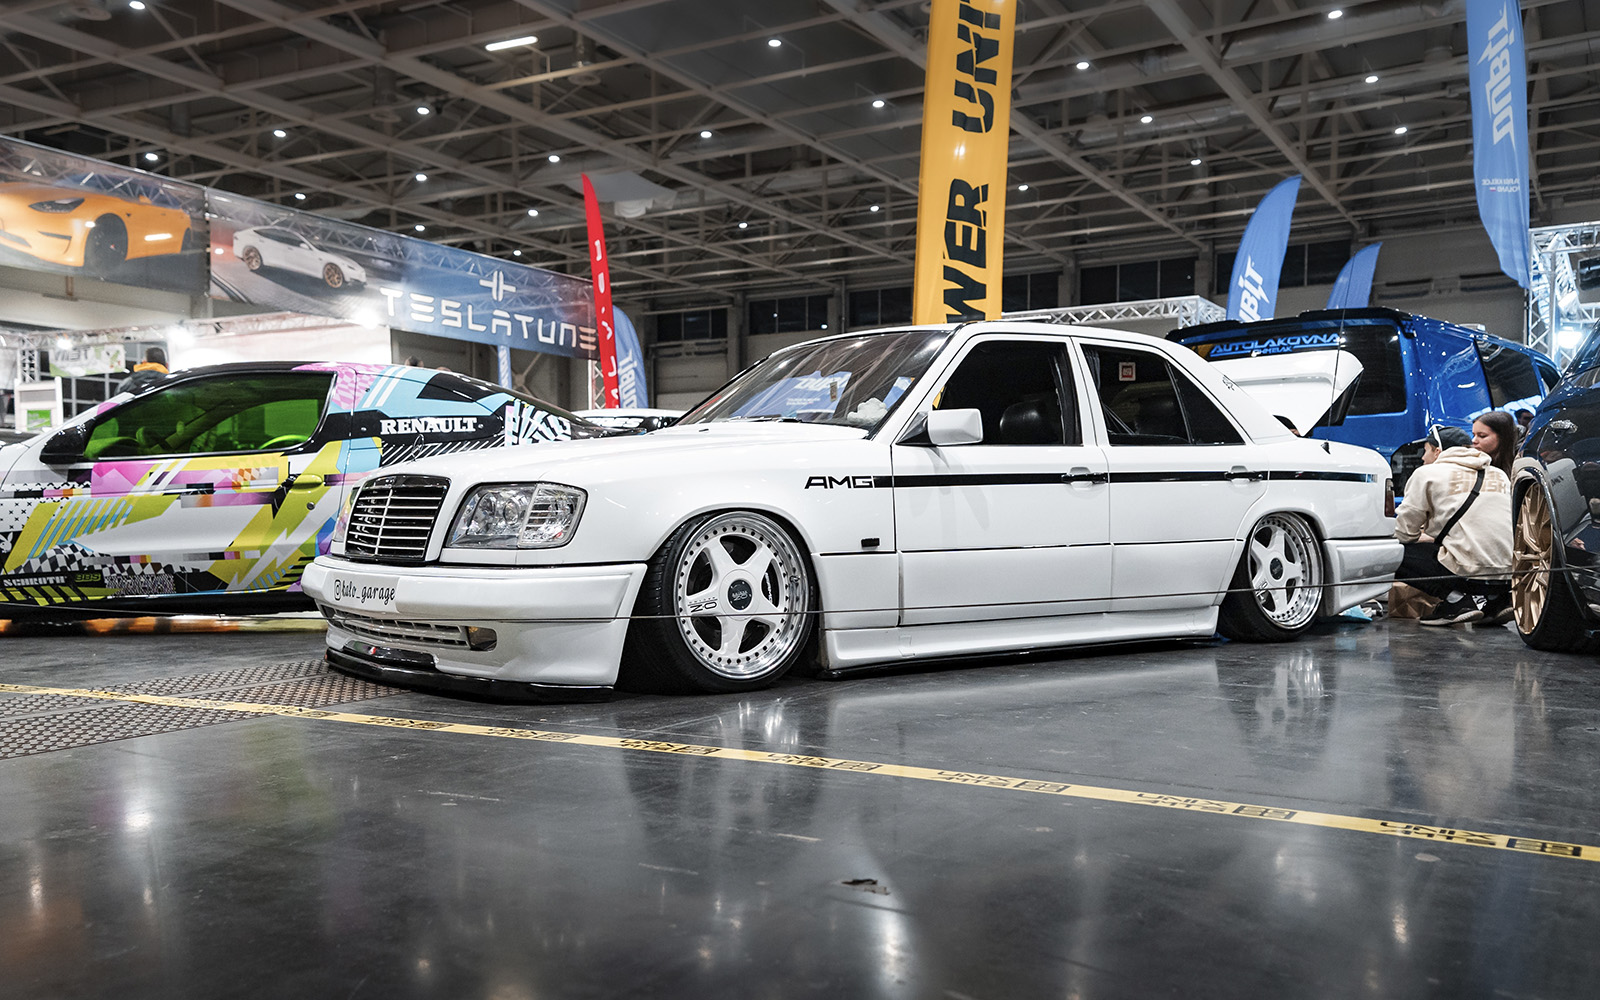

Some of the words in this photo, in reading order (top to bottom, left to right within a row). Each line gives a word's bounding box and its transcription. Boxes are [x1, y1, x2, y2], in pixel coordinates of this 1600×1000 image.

[379, 287, 597, 351] TESLATUNE
[380, 417, 478, 434] RENAULT
[804, 476, 873, 489] AMG
